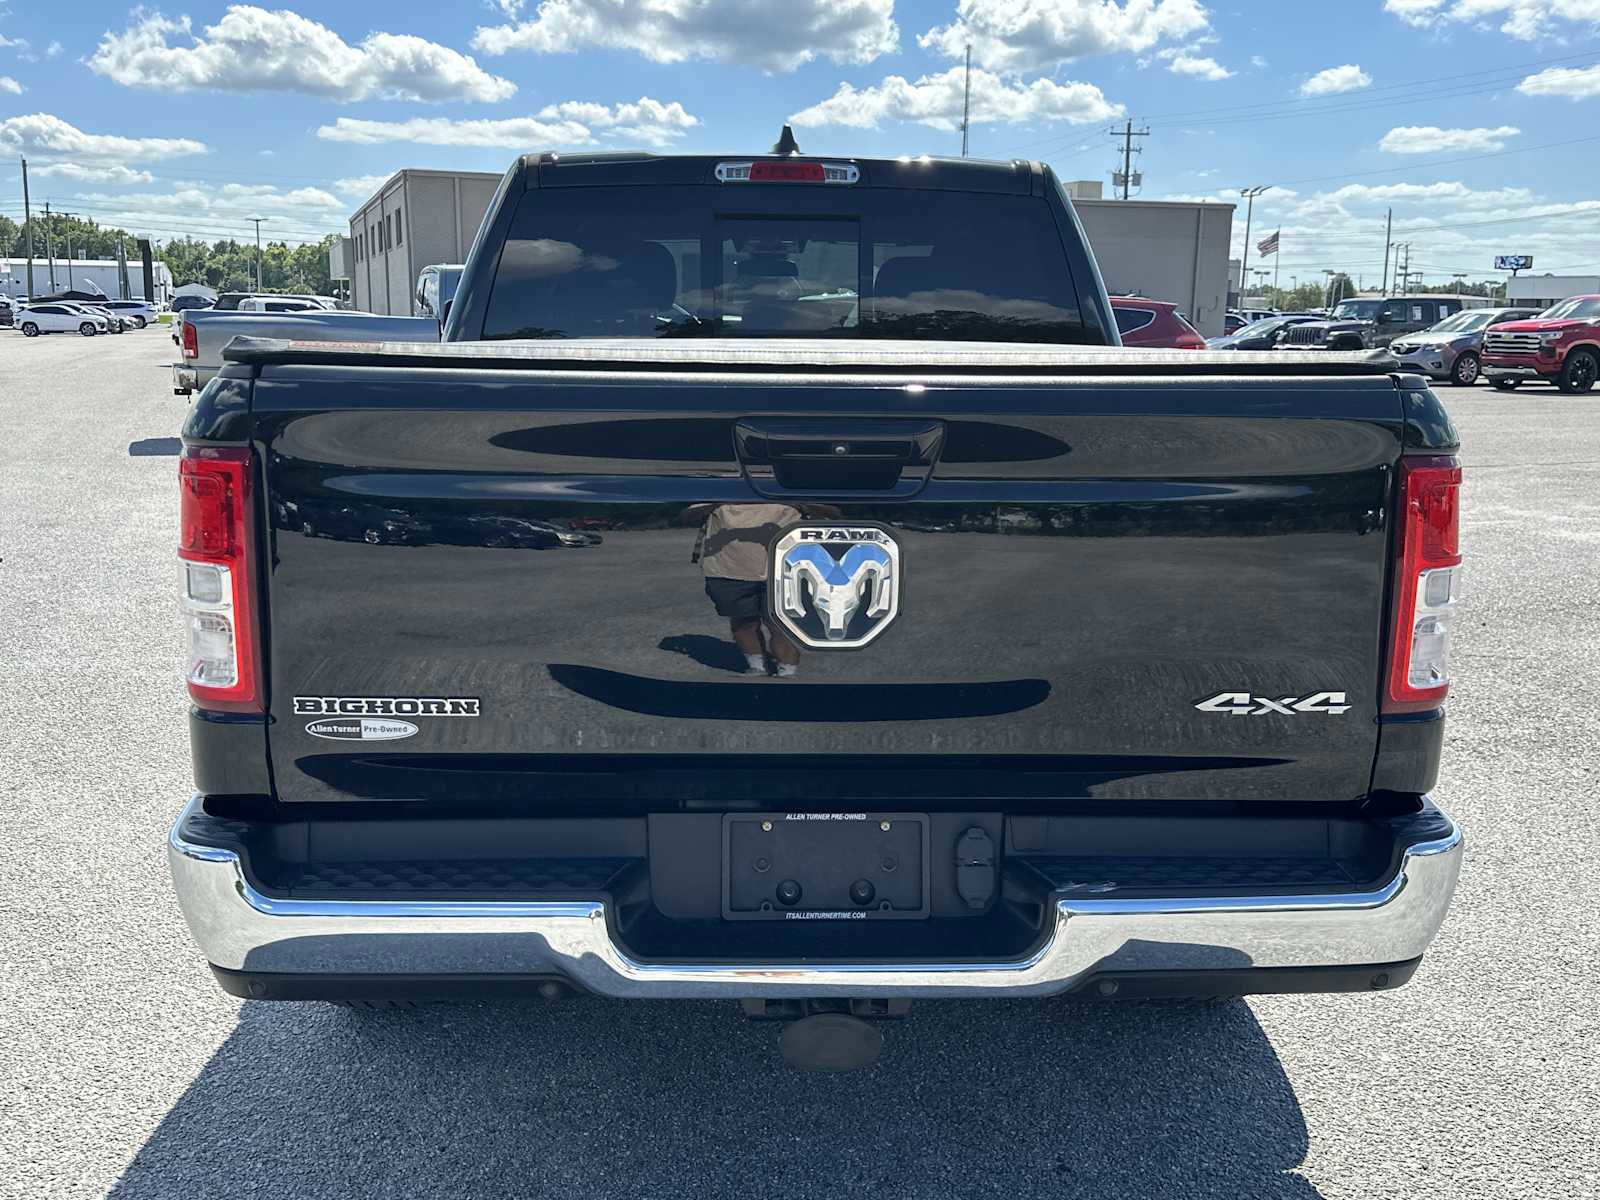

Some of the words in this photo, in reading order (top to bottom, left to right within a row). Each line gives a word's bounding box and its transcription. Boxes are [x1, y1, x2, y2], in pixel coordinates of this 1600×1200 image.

[800, 530, 875, 540] RAM
[293, 697, 480, 716] BIGHORN
[363, 724, 408, 733] Pre-Owned
